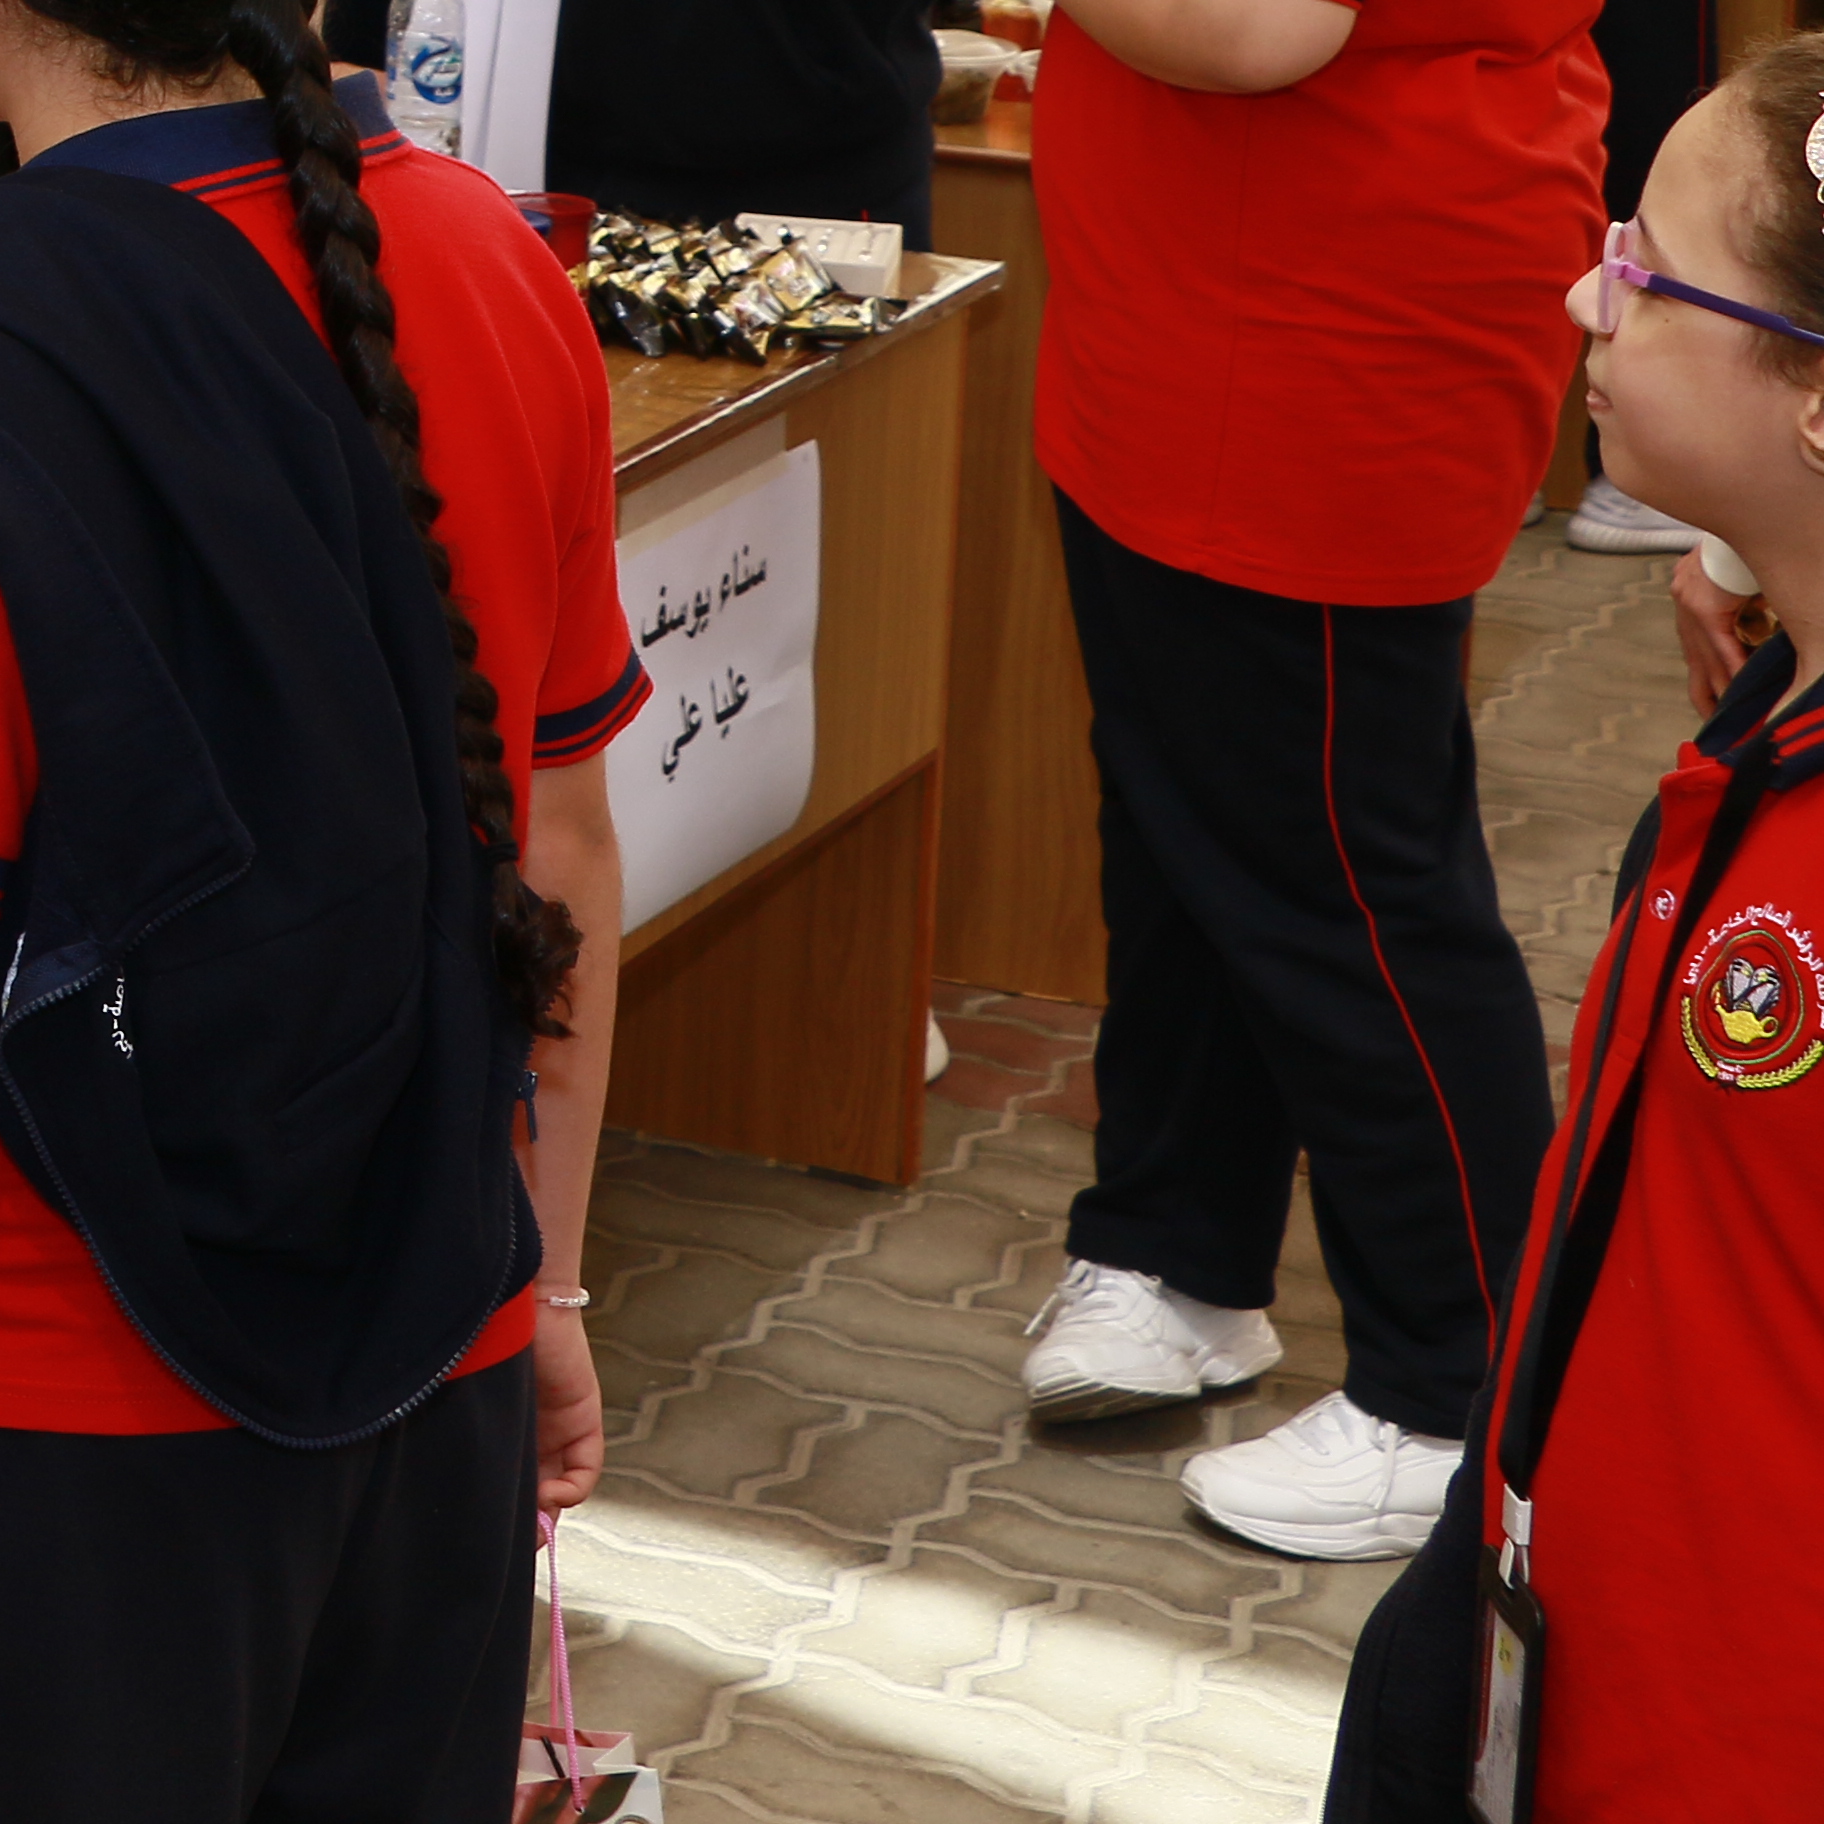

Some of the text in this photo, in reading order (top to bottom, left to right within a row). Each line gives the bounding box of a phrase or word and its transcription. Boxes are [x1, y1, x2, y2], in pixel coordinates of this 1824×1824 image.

[641, 584, 711, 648] يوسف
[662, 665, 749, 783] عليا علي
